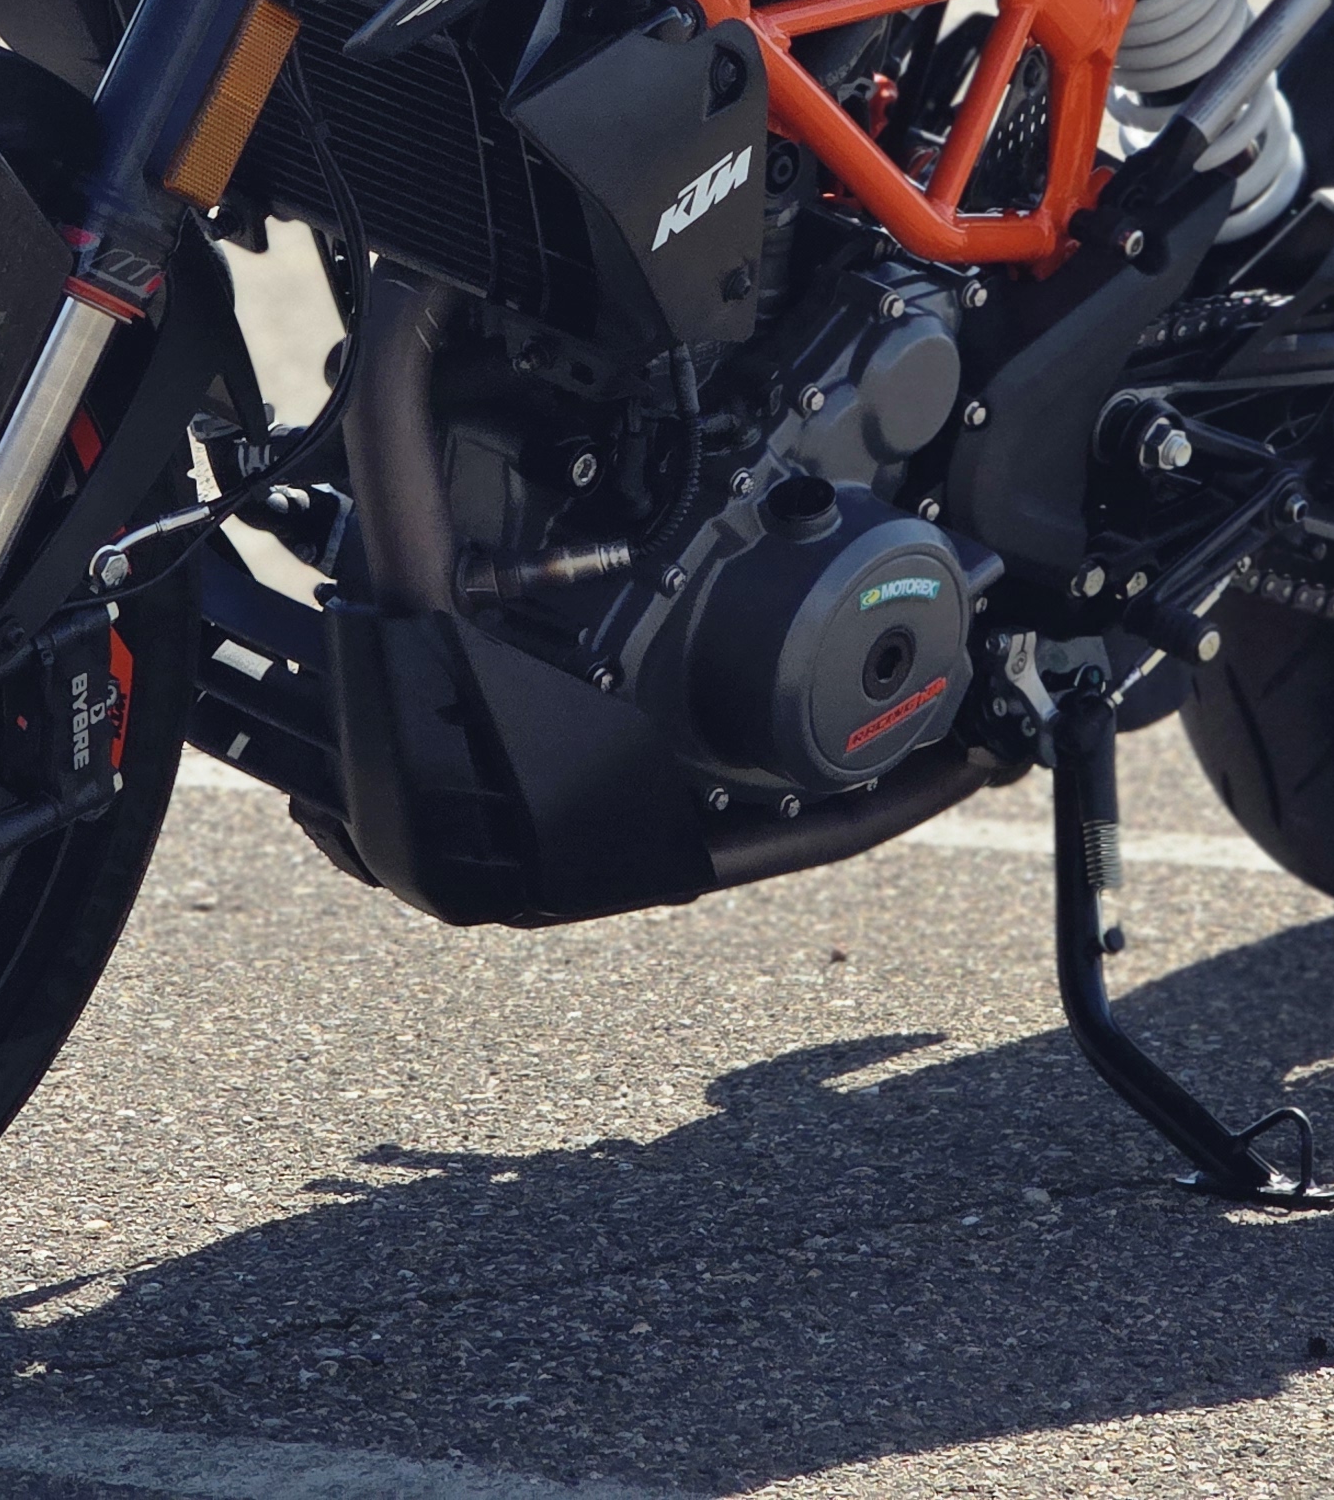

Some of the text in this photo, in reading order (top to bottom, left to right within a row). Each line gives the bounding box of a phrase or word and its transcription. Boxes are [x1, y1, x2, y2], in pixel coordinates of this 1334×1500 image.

[651, 145, 753, 252] KTM
[880, 578, 939, 600] MOTOREX
[71, 672, 90, 771] BYBRE
